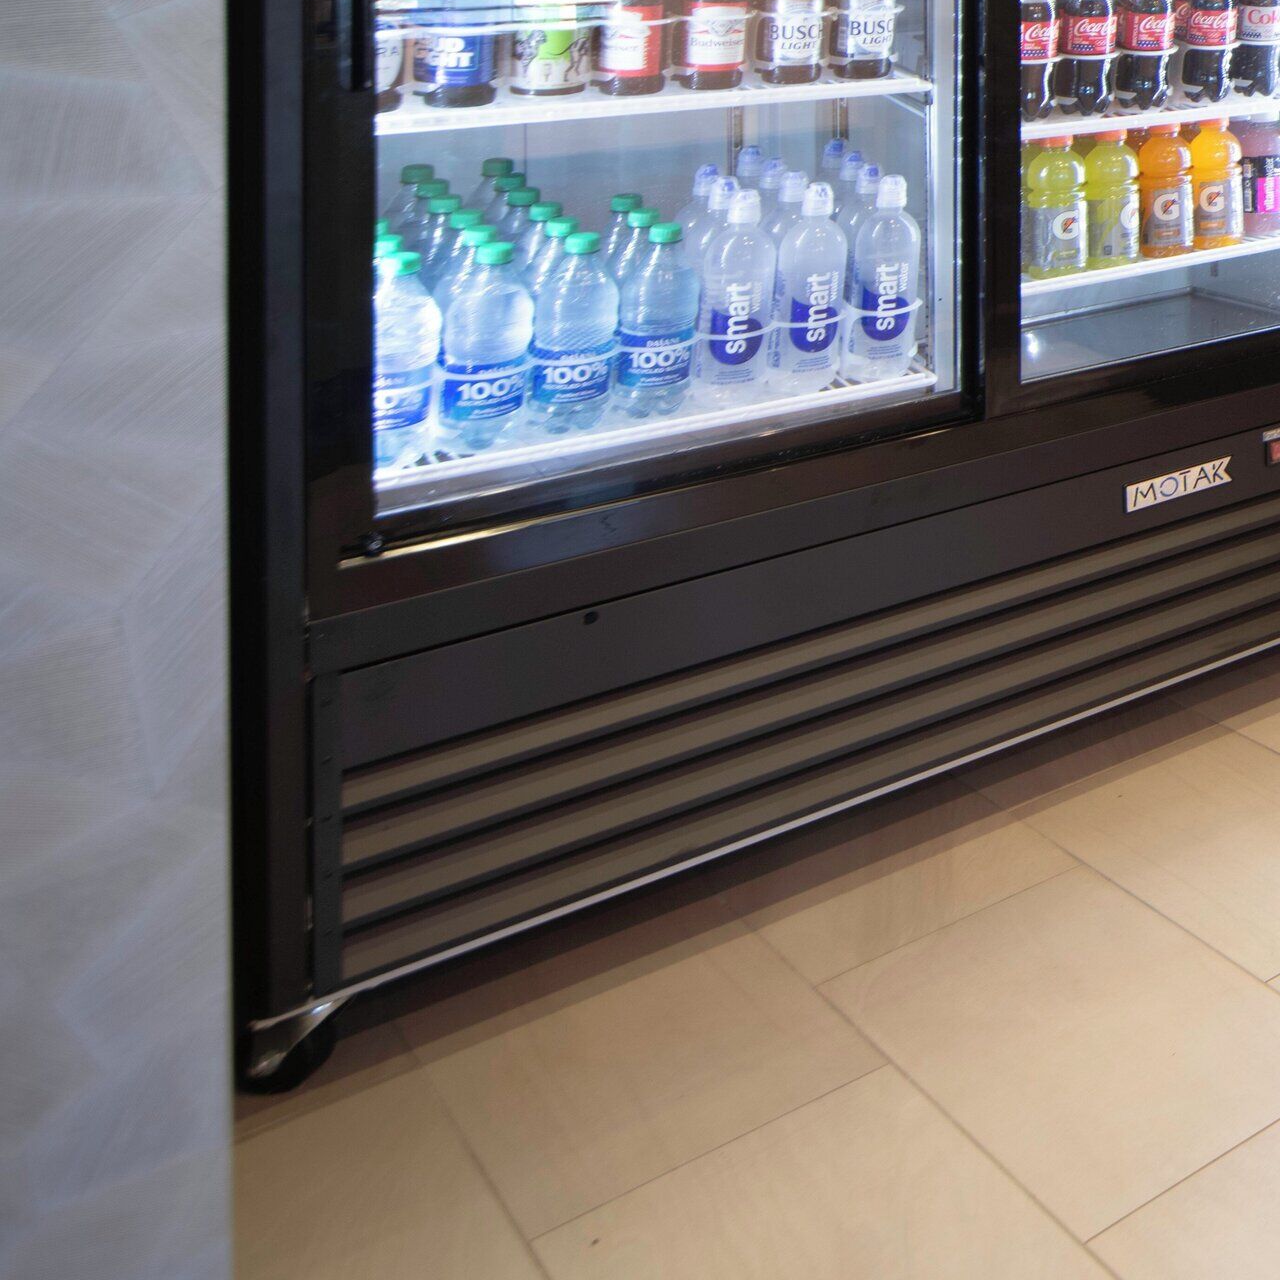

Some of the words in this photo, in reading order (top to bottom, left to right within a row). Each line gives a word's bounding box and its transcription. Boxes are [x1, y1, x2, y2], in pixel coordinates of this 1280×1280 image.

[771, 22, 825, 42] BUSCH
[850, 18, 894, 37] BUSC
[689, 35, 746, 50] Budweiser
[780, 40, 817, 52] LIGHT
[1153, 192, 1181, 220] G
[806, 271, 832, 343] smart
[876, 263, 900, 332] smart
[725, 282, 751, 355] smart
[630, 347, 690, 369] 100%
[543, 362, 607, 385] 100%
[457, 375, 524, 400] 100%
[1133, 461, 1225, 507] MOTAK
